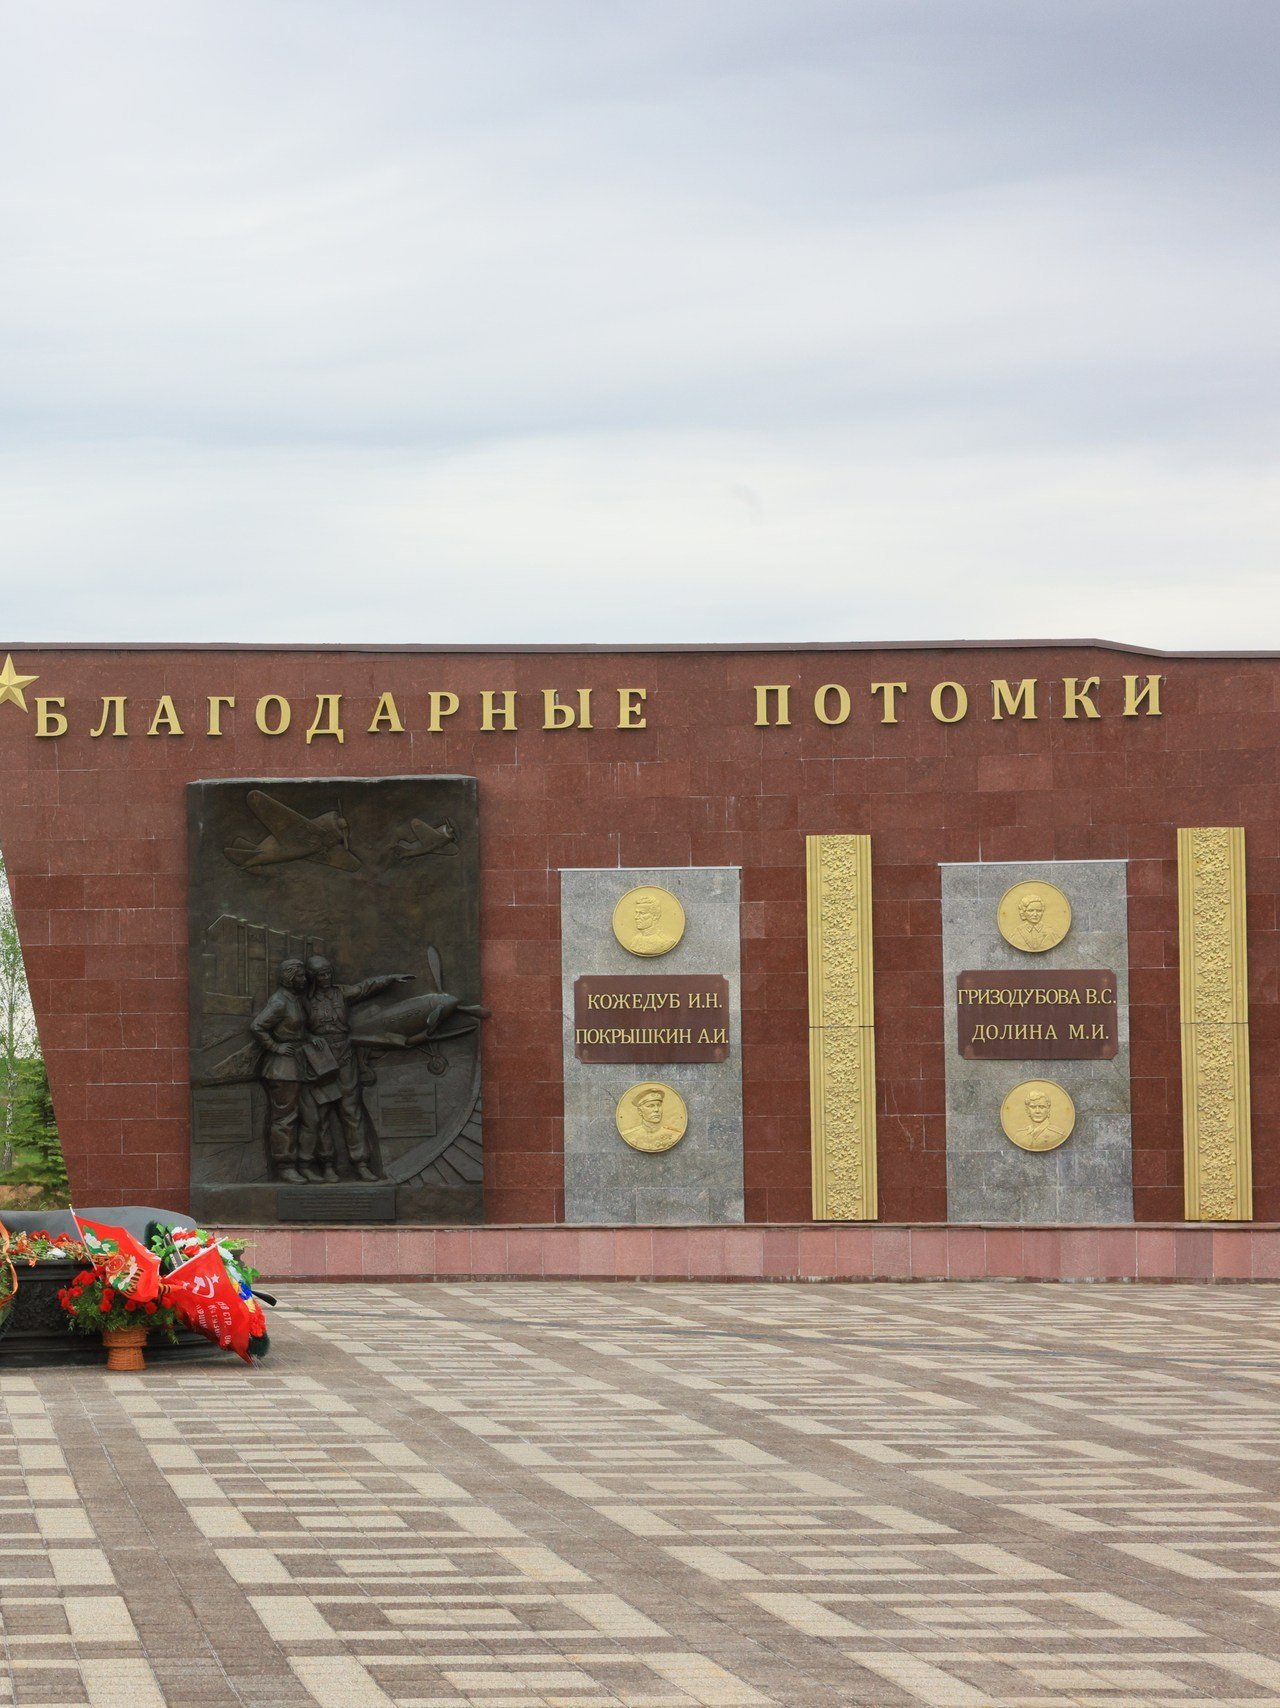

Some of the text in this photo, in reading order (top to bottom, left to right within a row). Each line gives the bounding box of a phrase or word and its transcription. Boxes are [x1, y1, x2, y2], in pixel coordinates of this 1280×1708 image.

[33, 674, 1163, 744] БЛАГОДАРНЫЕ ПОТОМКИ
[587, 993, 723, 1012] КОЖЕДУБ И.Н.
[957, 988, 1117, 1007] ГРИЗОДУБОВА В.С.
[575, 1028, 729, 1044] ПОКРЫШКИН А.И.
[972, 1024, 1110, 1043] ДОЛИНА М.И.
